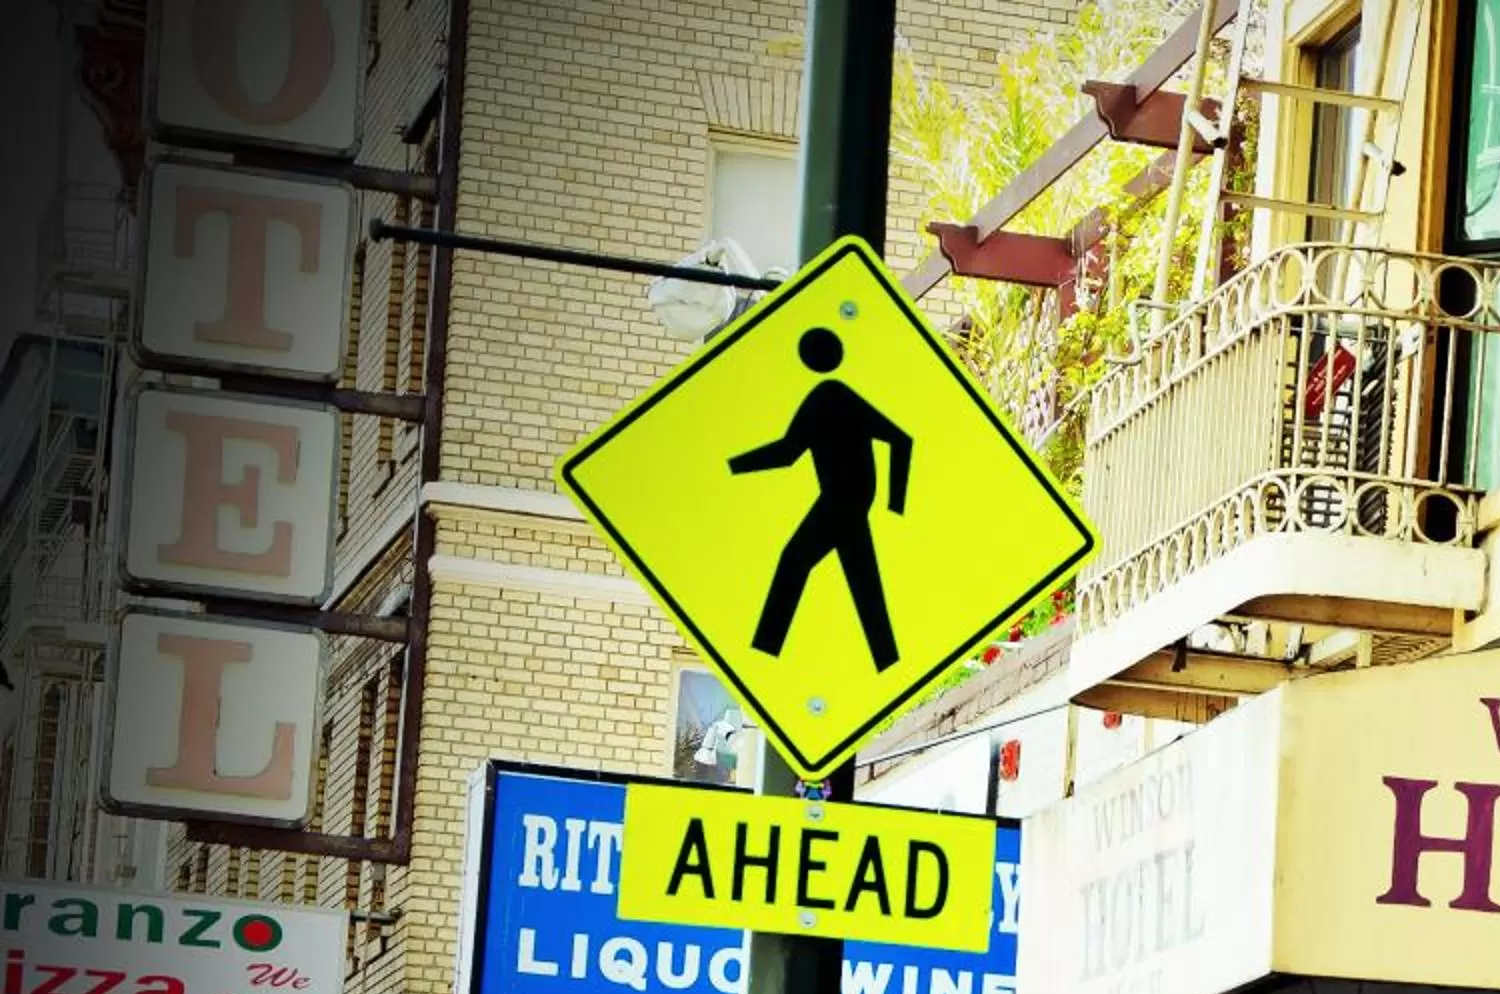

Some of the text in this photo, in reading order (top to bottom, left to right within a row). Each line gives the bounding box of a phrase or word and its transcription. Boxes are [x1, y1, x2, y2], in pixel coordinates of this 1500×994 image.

[517, 813, 624, 896] RIT
[667, 816, 950, 920] AHEAD
[1079, 838, 1206, 982] HOTEL
[245, 963, 312, 990] We
[517, 928, 742, 994] LIQUO
